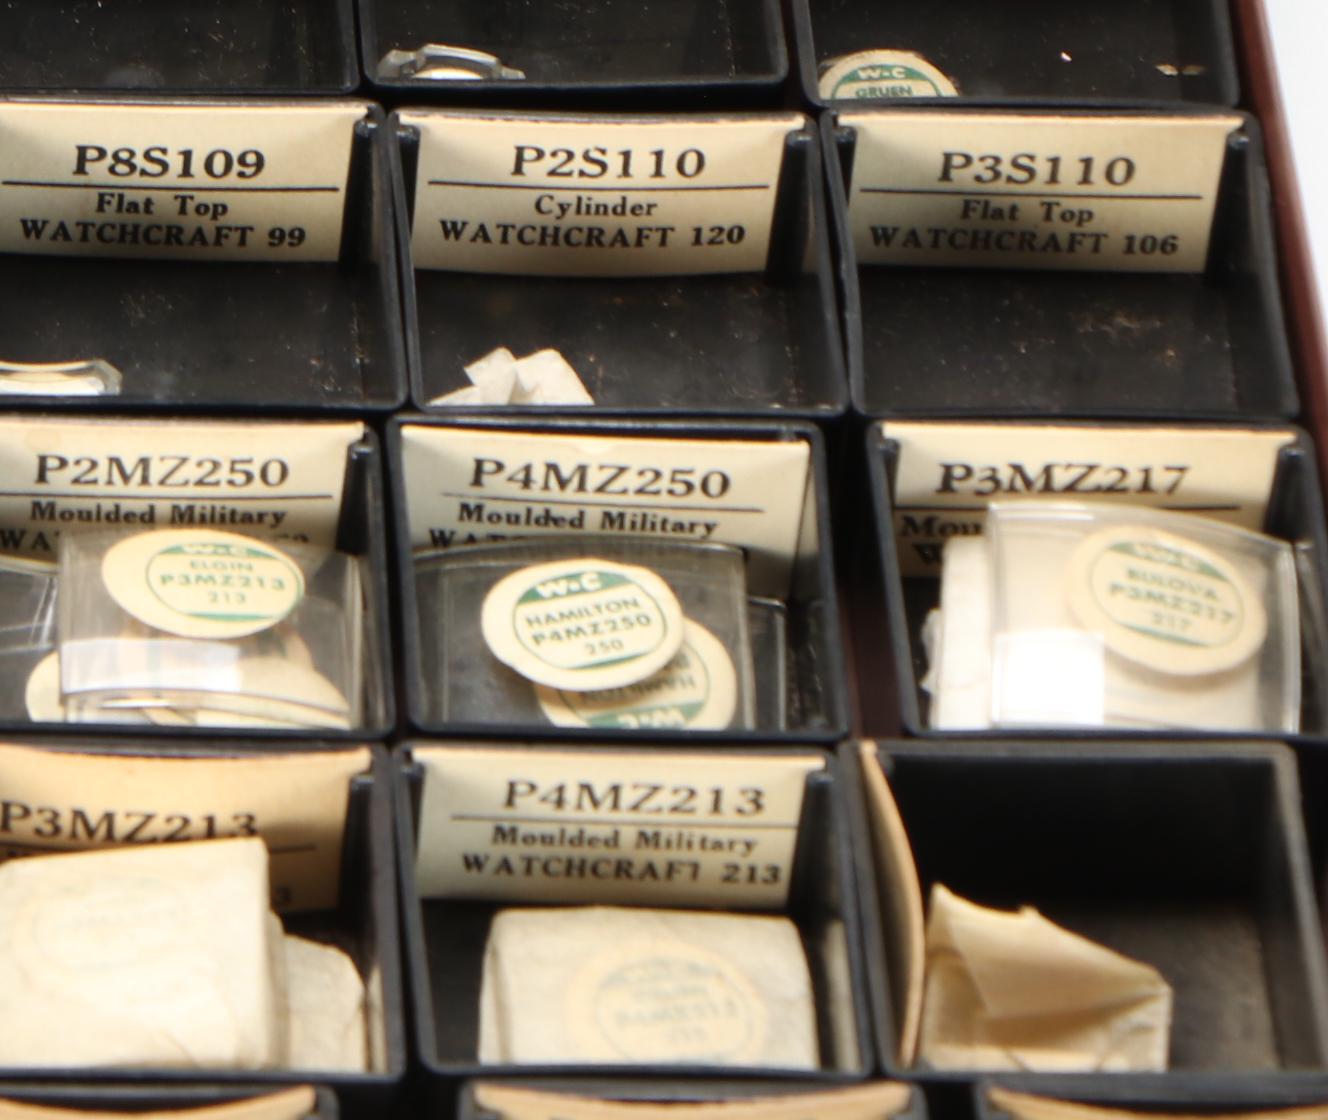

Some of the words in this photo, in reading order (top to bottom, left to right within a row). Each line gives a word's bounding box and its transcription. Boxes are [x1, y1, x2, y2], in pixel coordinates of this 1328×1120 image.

[855, 84, 912, 98] GRUEN
[73, 146, 264, 179] P8S109
[512, 146, 705, 178] P2S110
[939, 153, 1135, 185] P3S110
[96, 193, 154, 215] Flat
[174, 195, 228, 221] Top
[535, 195, 657, 220] Cylinder
[961, 200, 1017, 220] Flat
[1041, 202, 1093, 227] Top
[871, 227, 1107, 253] WATCHCRAFT
[1124, 235, 1177, 254] 106
[36, 455, 288, 486] P2MZ250
[471, 459, 730, 497] P4MZ250
[937, 464, 1187, 497] P3MZ217
[31, 501, 161, 529] Moulded
[170, 505, 284, 529] Military
[459, 503, 584, 528] Moulded
[601, 511, 716, 540] Military
[190, 559, 254, 572] ELGIN
[525, 598, 641, 627] HAMILTON
[532, 615, 652, 644] P4MZ250
[584, 638, 623, 655] 250
[506, 782, 762, 814] P4MZ213
[0, 801, 258, 842] P3MZ213
[494, 826, 619, 847] Moulded
[639, 832, 752, 851] Military
